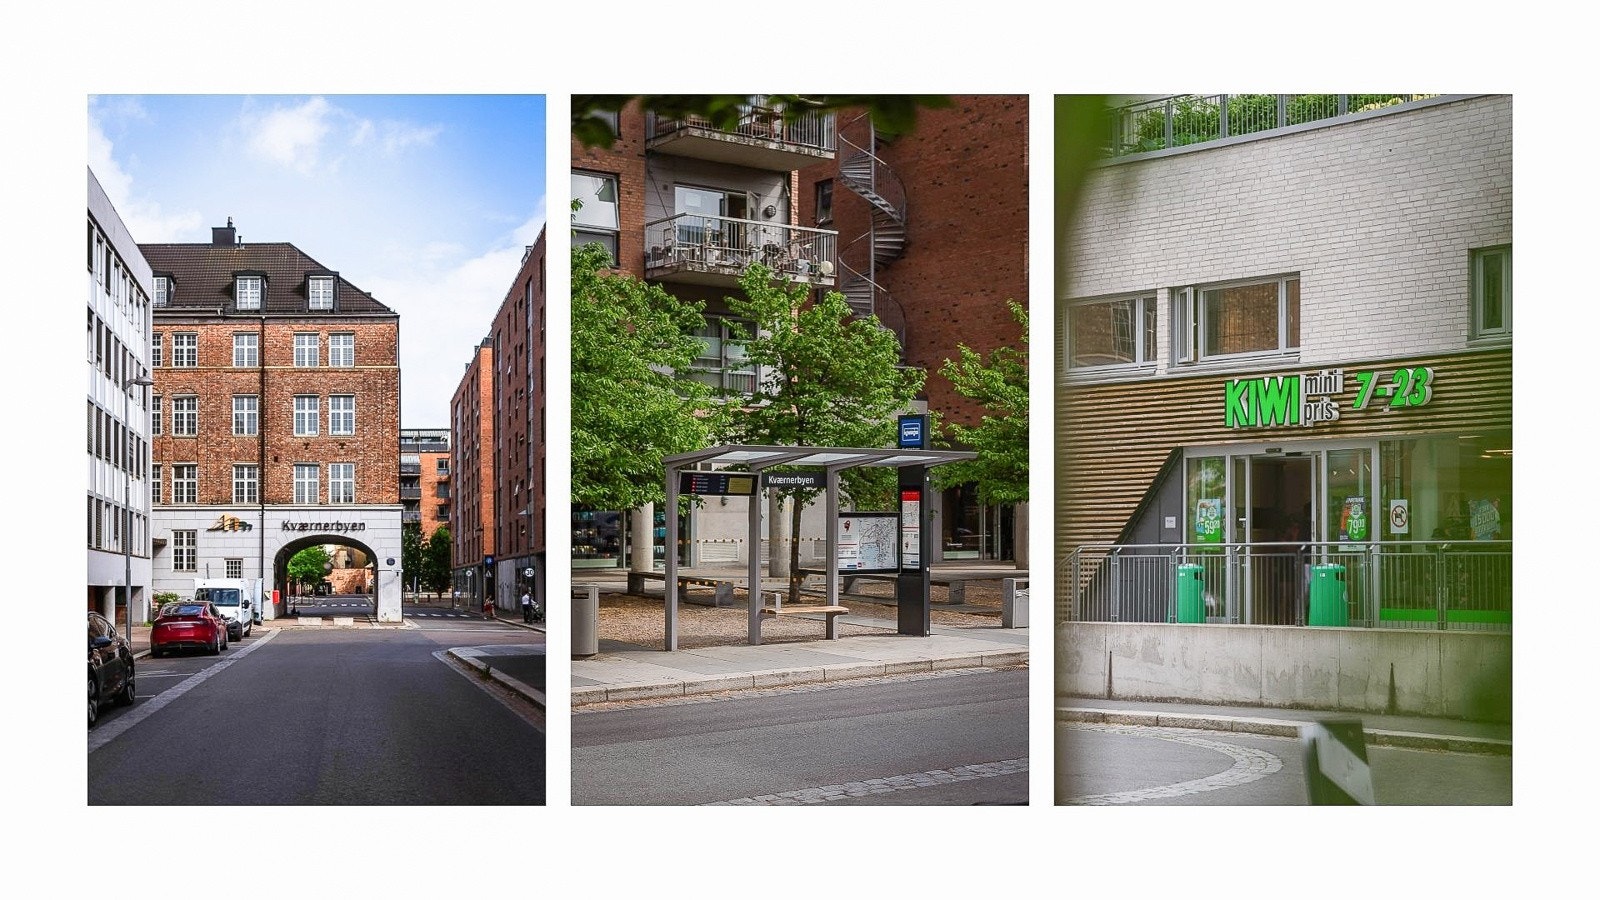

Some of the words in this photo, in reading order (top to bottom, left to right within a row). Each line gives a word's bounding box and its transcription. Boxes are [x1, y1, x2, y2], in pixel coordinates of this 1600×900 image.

[1304, 369, 1339, 394] mini
[1224, 375, 1301, 428] KIWI
[1304, 397, 1333, 426] pris
[768, 475, 815, 487] Kværnerbyen
[281, 519, 366, 534] Kværnerbyen
